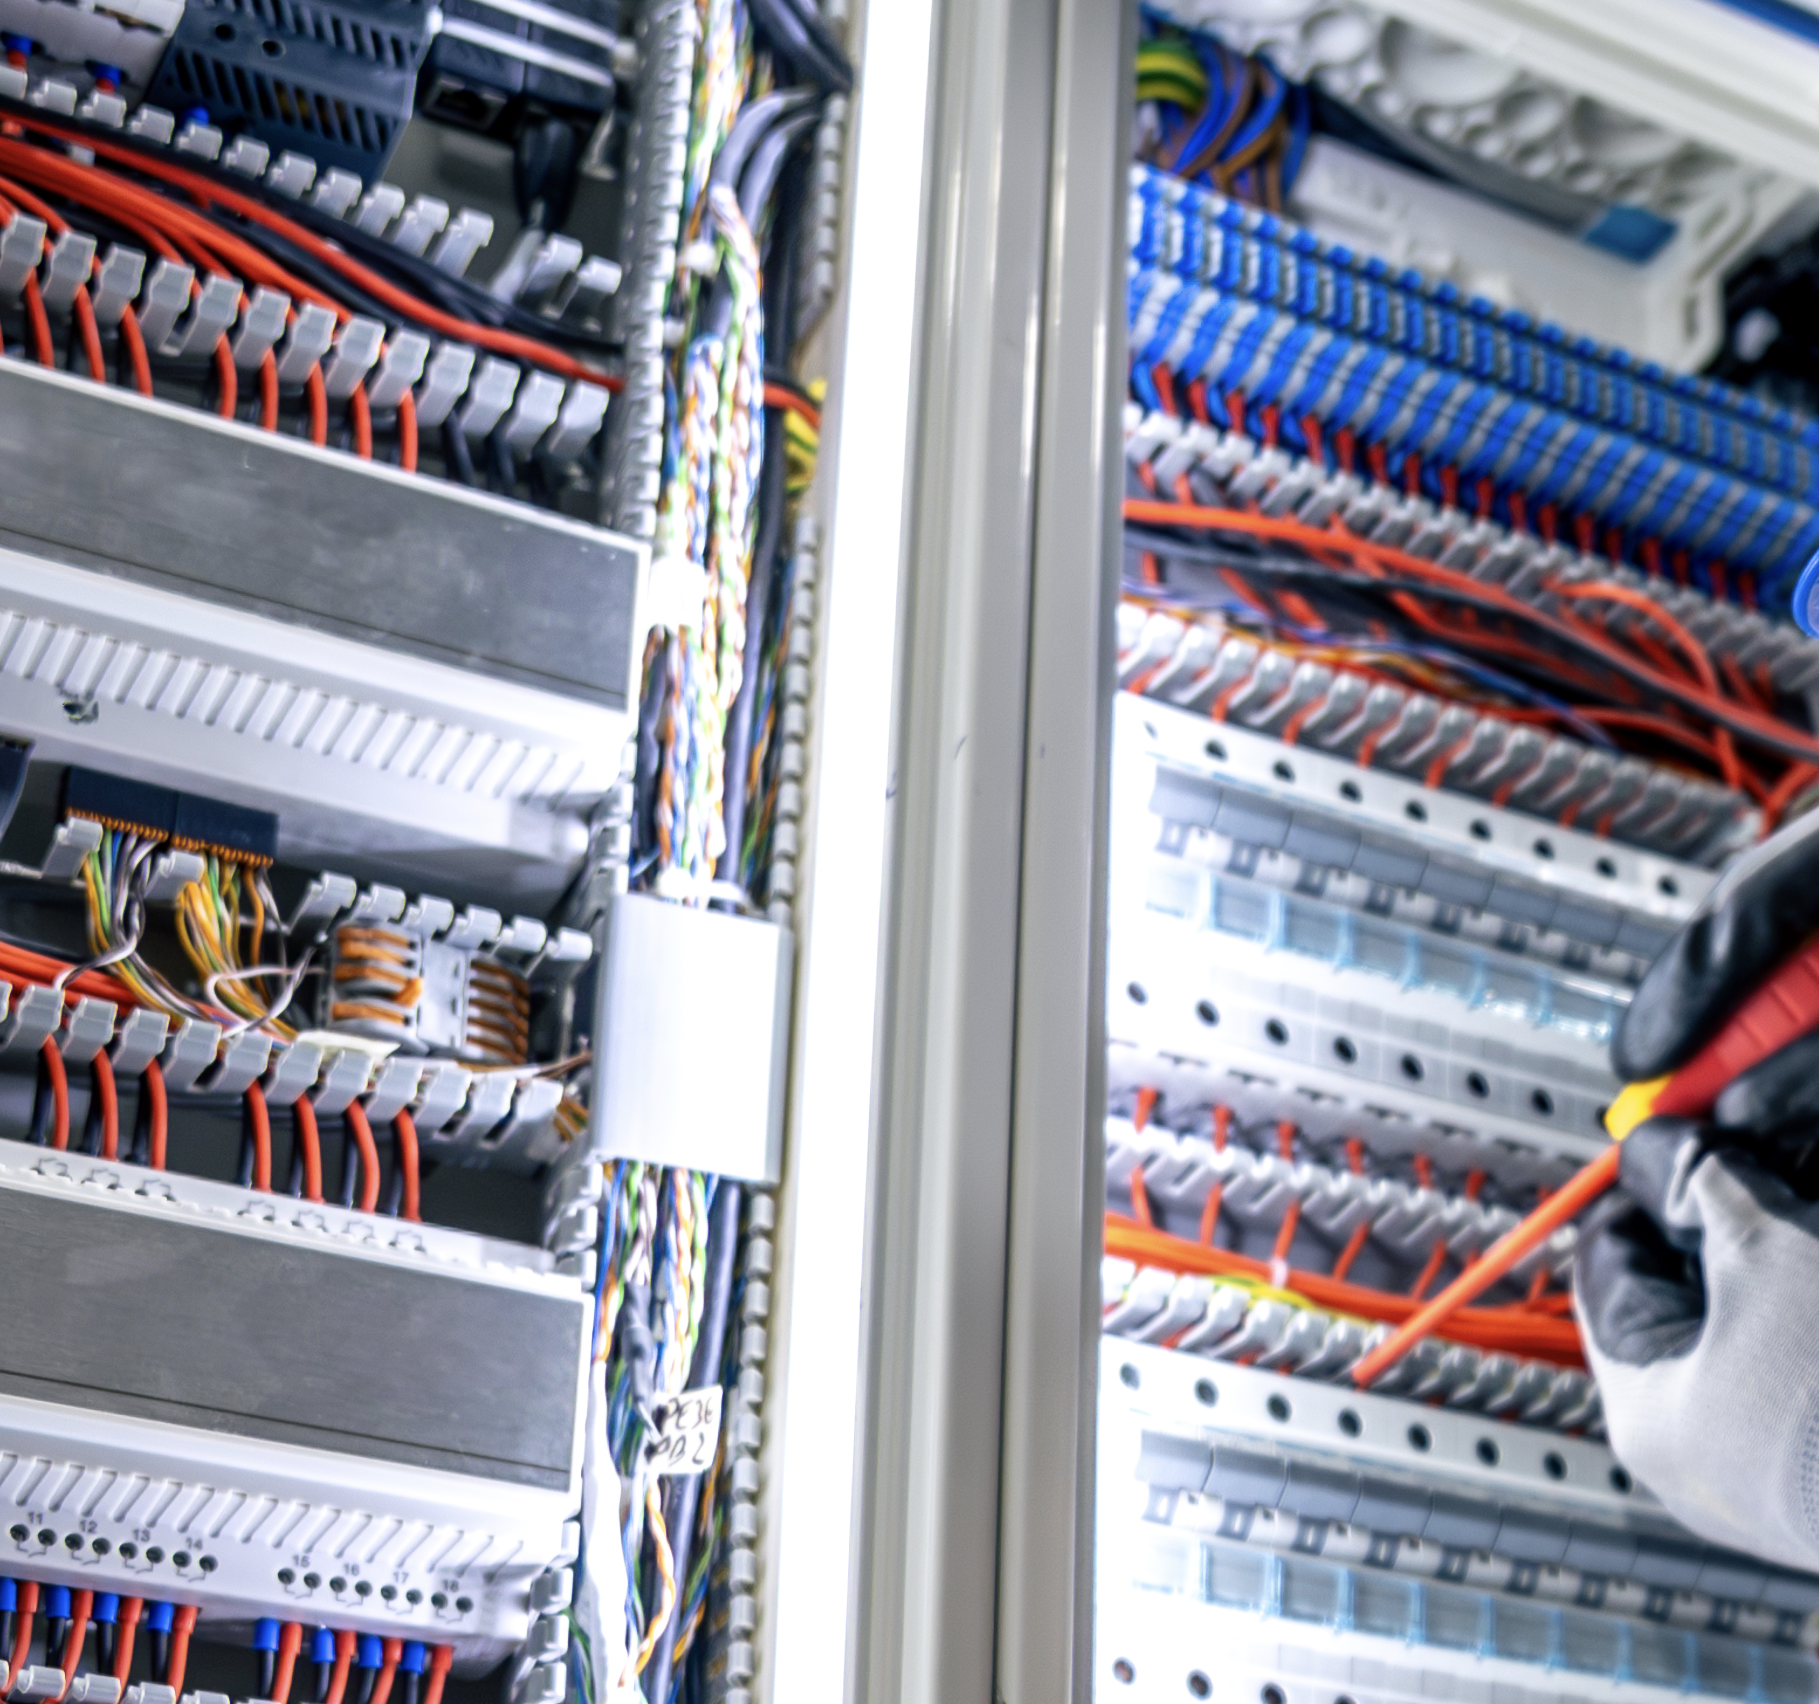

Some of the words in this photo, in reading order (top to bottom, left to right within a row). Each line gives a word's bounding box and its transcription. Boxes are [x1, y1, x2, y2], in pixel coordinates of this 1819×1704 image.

[27, 1511, 44, 1525] 11
[79, 1519, 98, 1534] 12
[132, 1528, 152, 1543] 13
[185, 1536, 204, 1551] 14
[393, 1570, 410, 1585] 17
